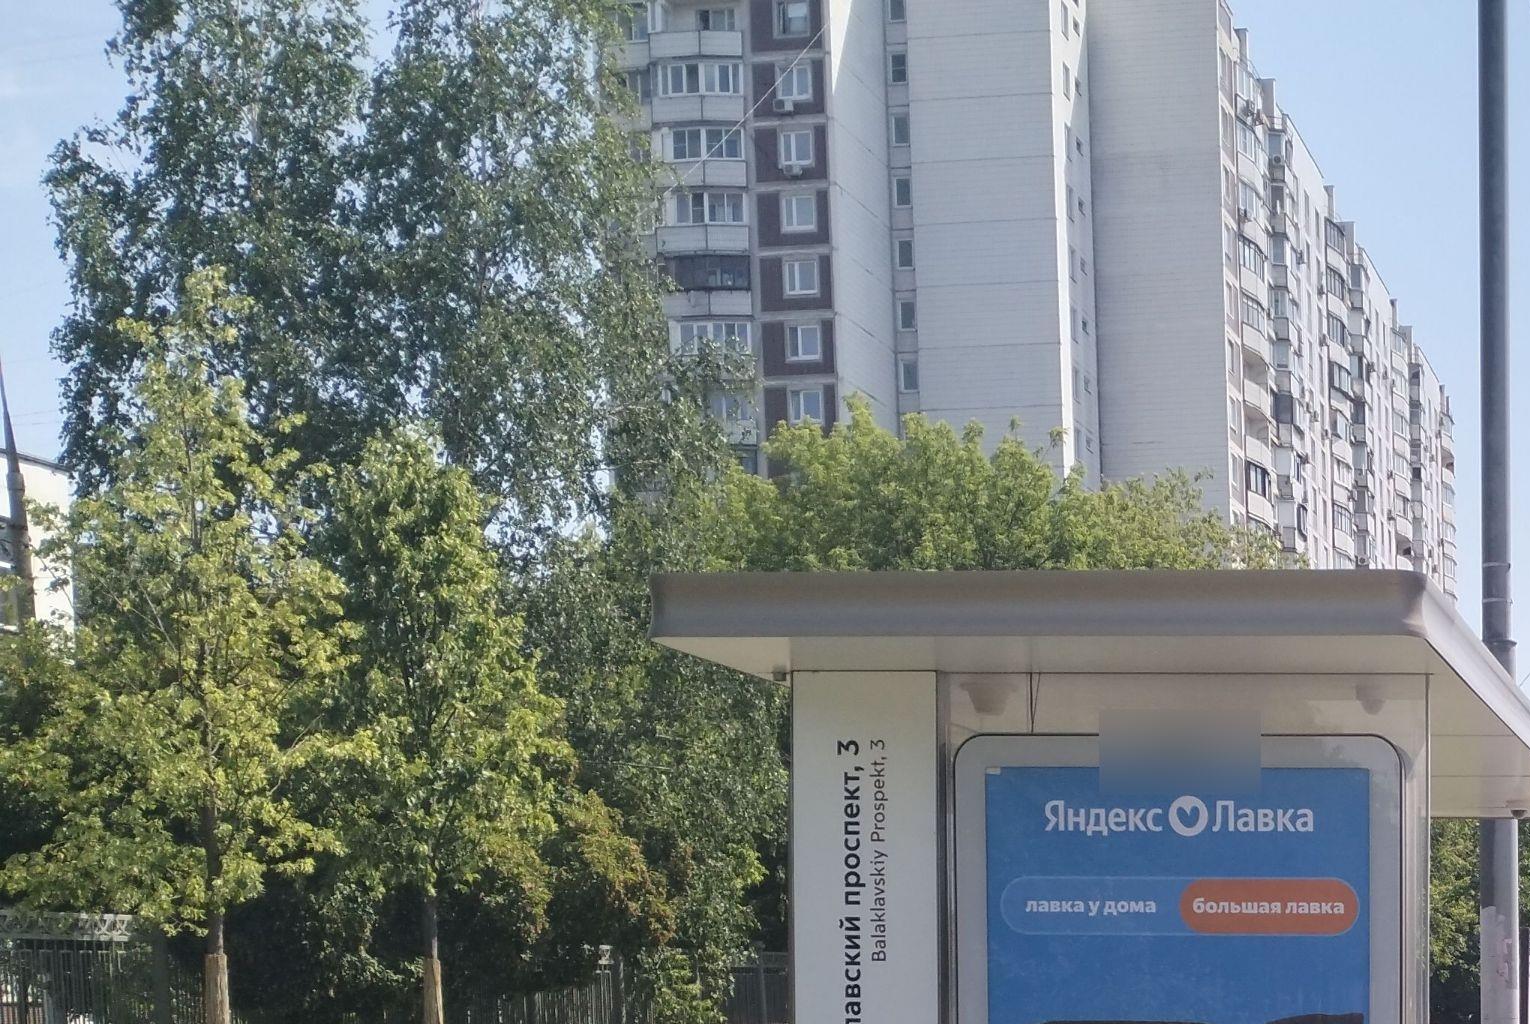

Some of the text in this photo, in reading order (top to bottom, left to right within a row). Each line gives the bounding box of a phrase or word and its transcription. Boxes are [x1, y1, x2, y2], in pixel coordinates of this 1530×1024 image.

[837, 740, 860, 757] 3
[1045, 800, 1314, 836] Яндекс Лавка
[841, 765, 865, 906] проспект,
[869, 740, 889, 962] Balaklavskiy Prospekt, 3
[1026, 900, 1157, 917] лавка у дома
[1192, 898, 1345, 915] большая лавка
